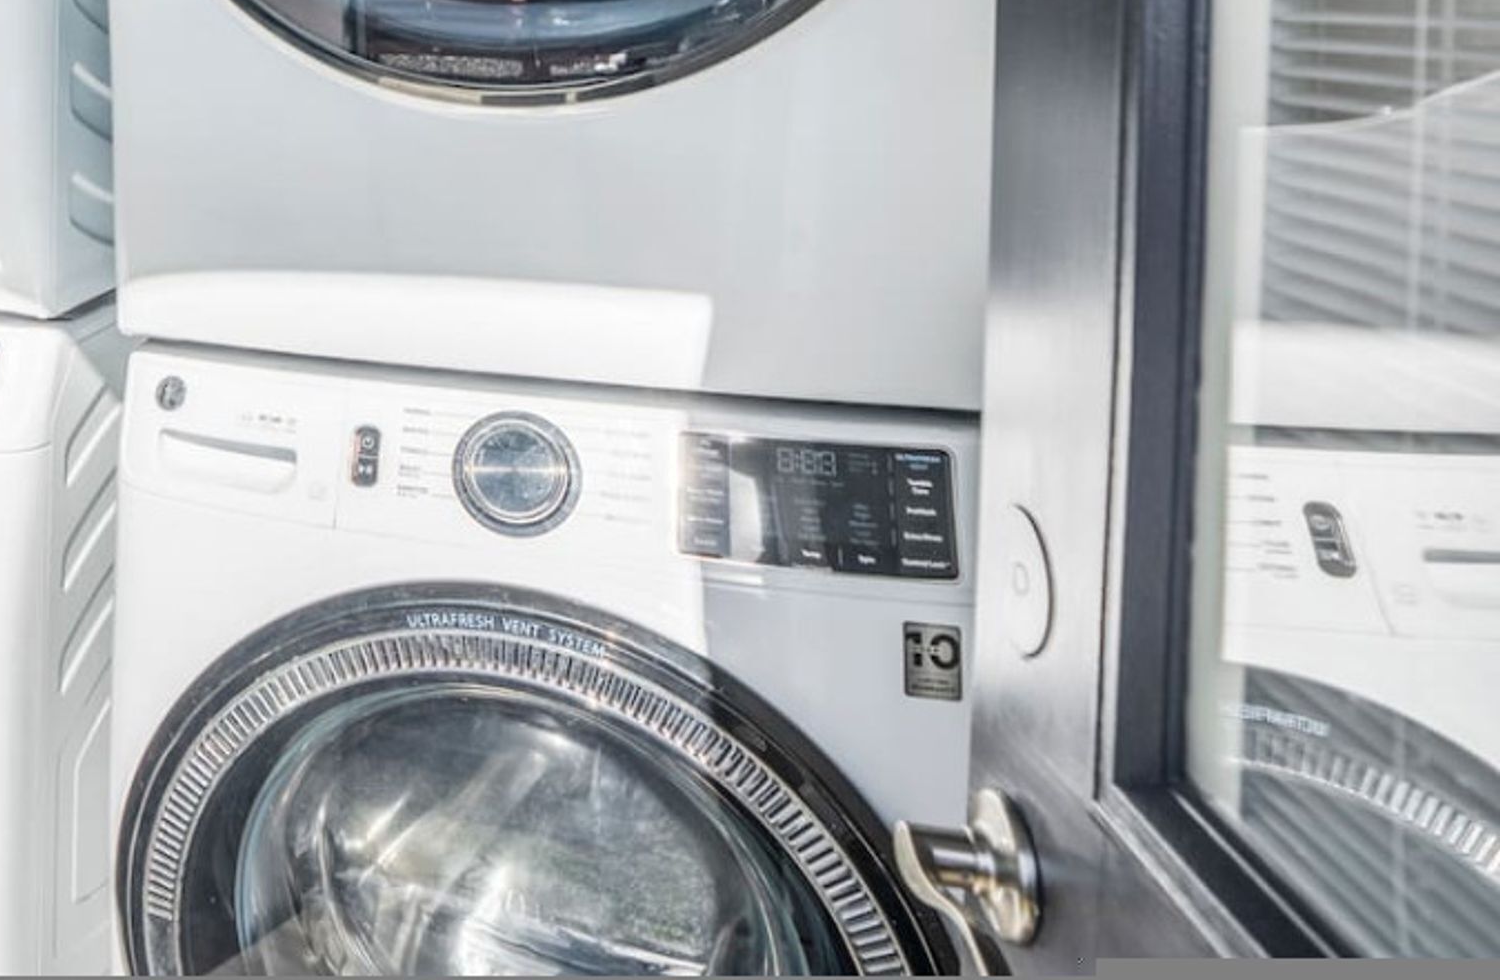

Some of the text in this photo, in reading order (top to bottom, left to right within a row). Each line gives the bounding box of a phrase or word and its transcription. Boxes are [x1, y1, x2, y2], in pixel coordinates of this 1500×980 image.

[406, 612, 607, 657] ULTRAFRESH VENT SYSTEM
